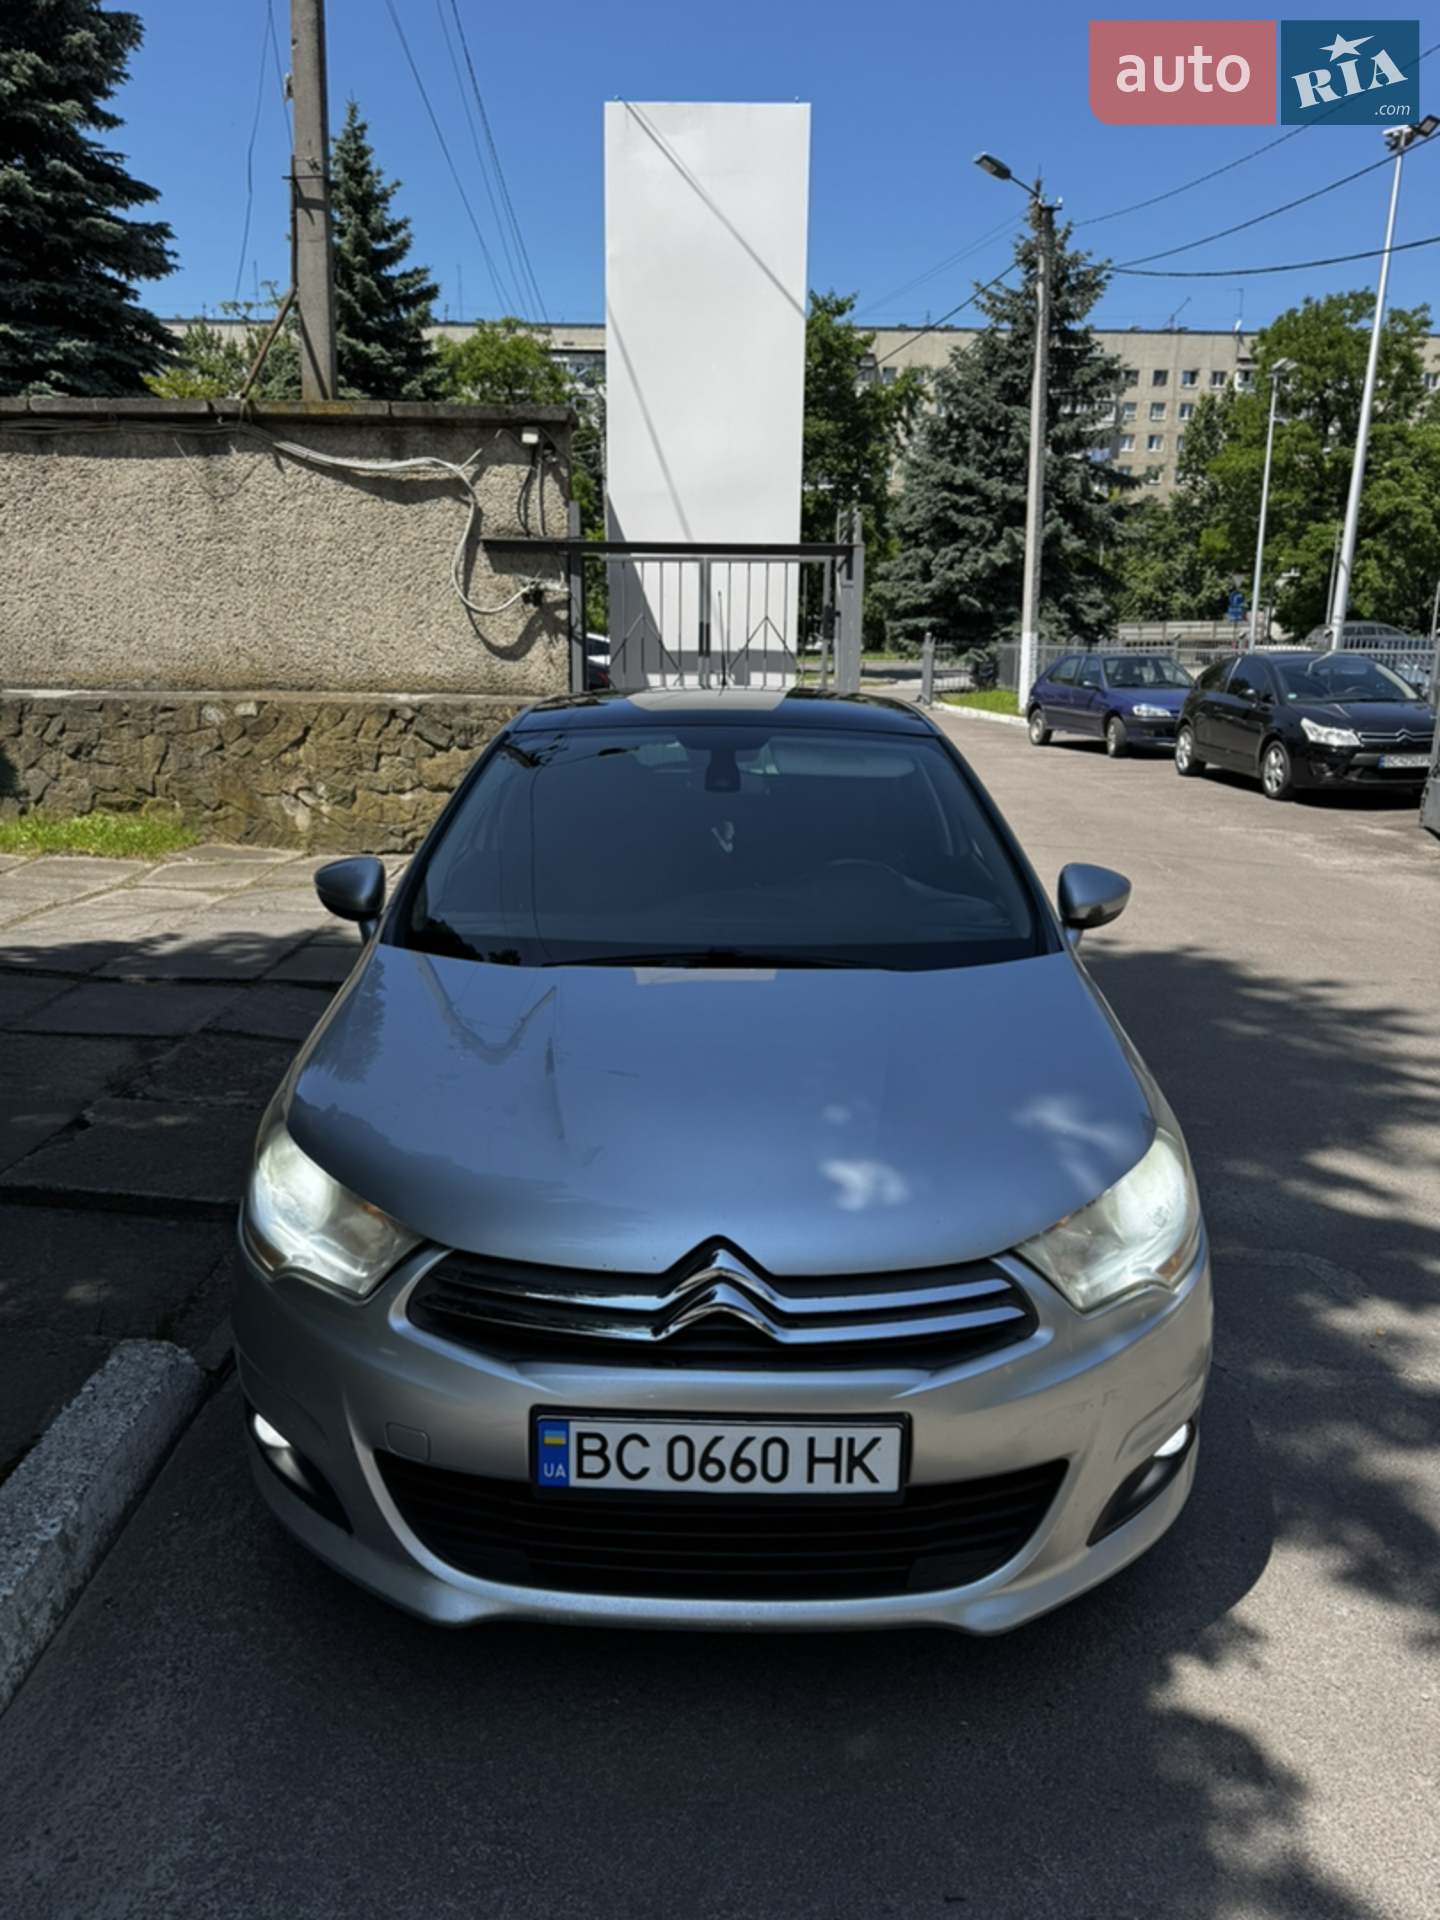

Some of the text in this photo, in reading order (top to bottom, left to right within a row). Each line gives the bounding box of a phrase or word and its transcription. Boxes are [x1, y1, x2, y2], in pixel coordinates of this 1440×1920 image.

[544, 1463, 566, 1478] UA
[576, 1431, 882, 1484] BC 0660 HK
